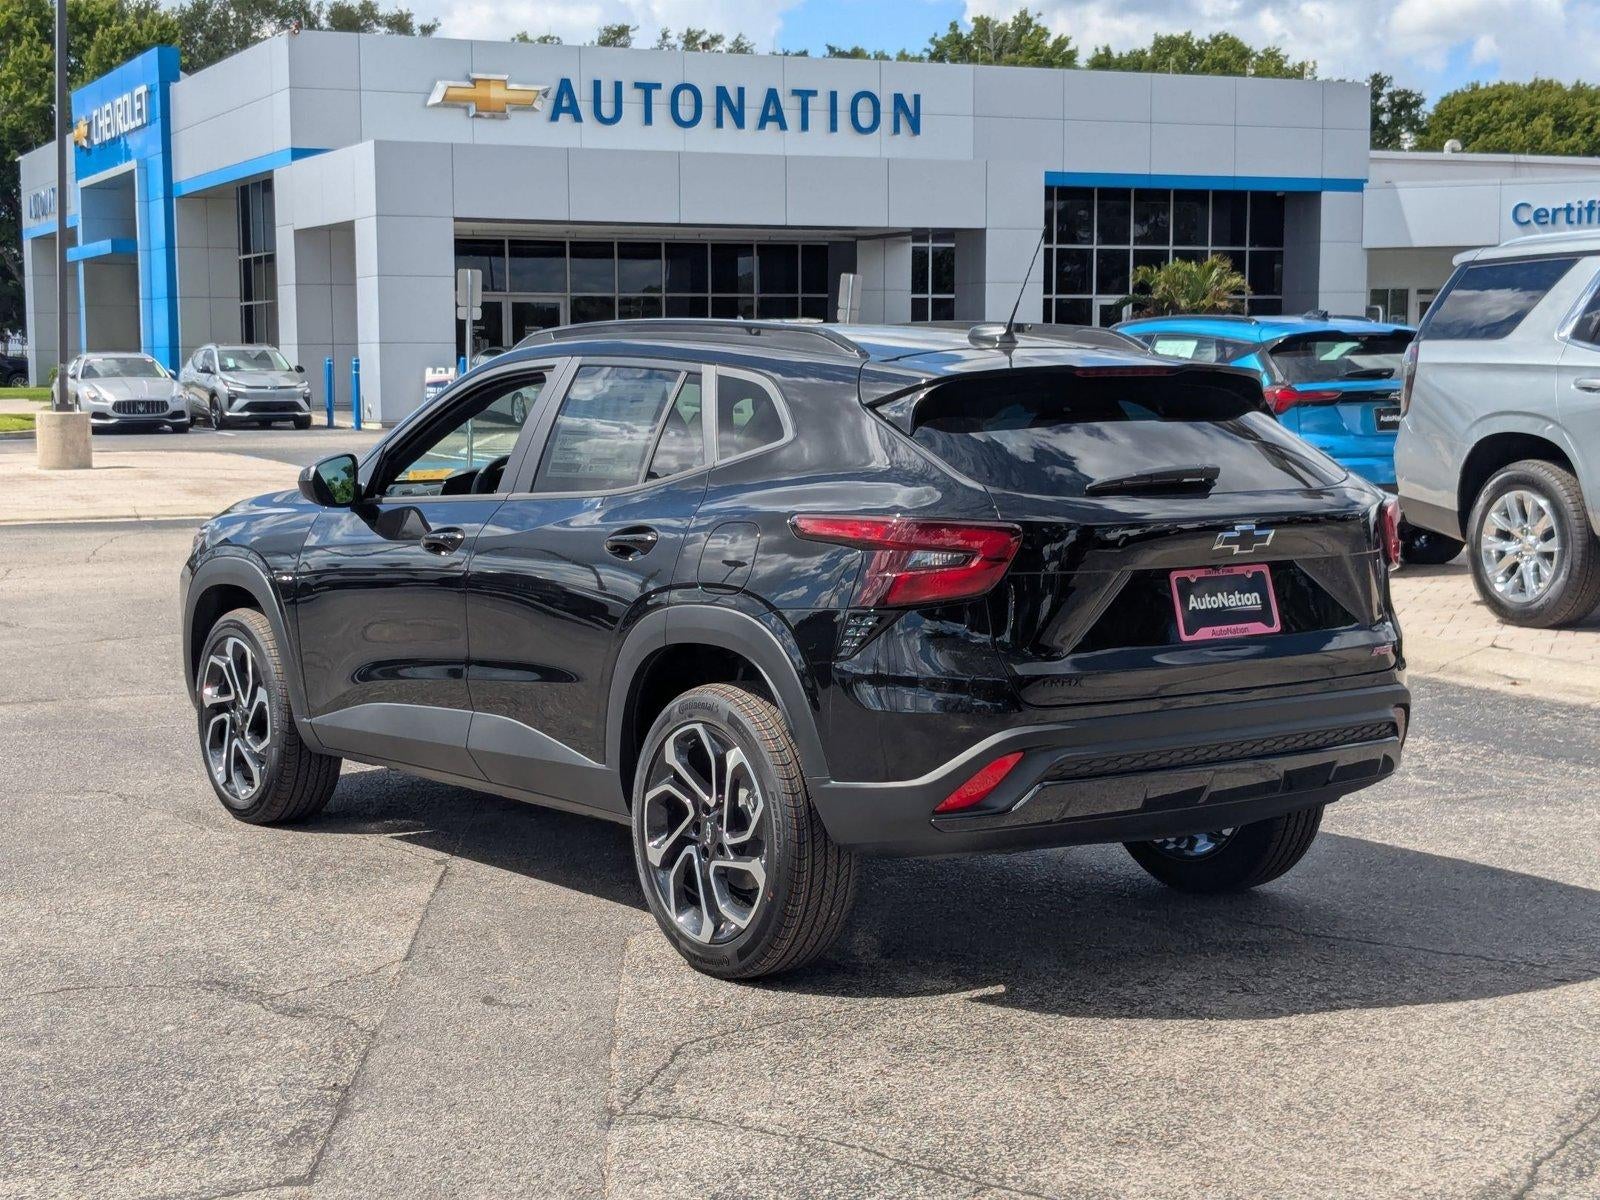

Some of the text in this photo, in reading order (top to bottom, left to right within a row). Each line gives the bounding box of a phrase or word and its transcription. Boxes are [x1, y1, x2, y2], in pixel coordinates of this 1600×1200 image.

[92, 84, 148, 144] CHEVROLET
[549, 78, 922, 136] AUTONATION
[1188, 591, 1261, 610] AutoNation
[1211, 626, 1249, 637] AutoNation
[678, 701, 714, 714] Continental
